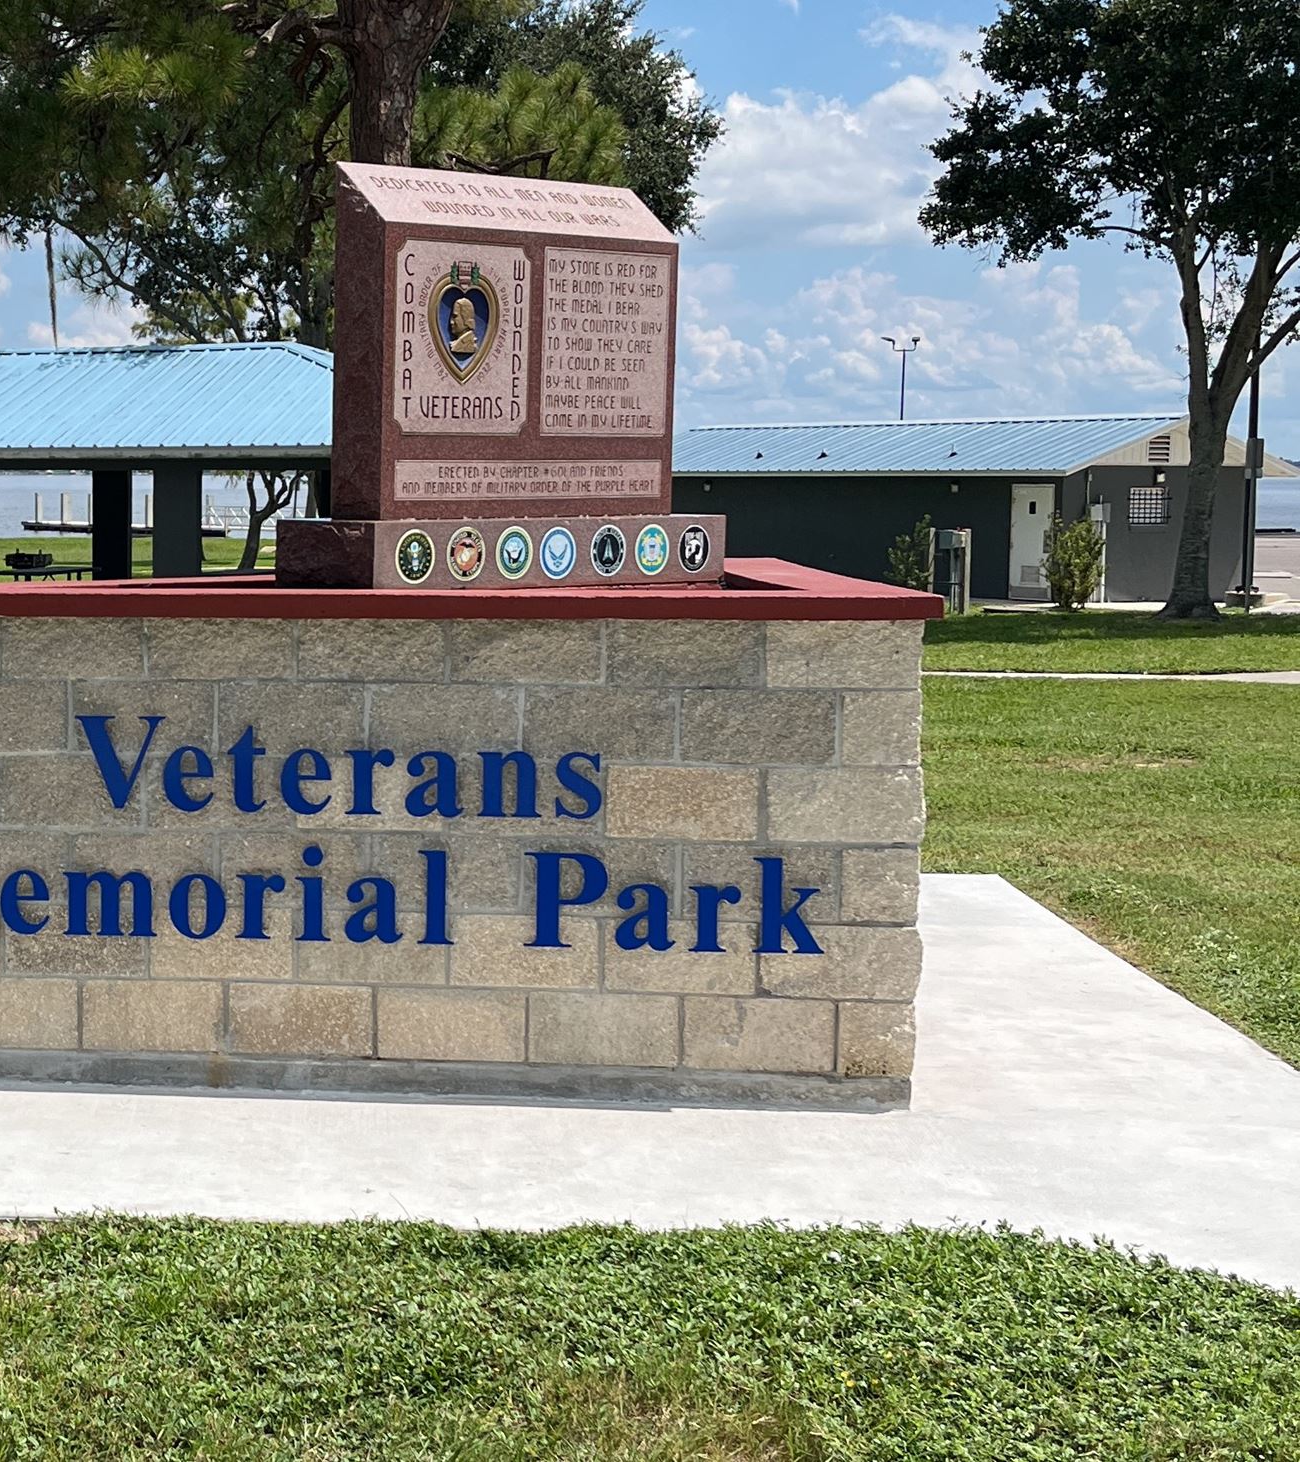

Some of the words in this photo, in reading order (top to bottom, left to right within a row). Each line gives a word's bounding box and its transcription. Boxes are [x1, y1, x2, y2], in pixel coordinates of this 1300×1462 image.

[369, 175, 456, 195] DEDICATED
[458, 183, 482, 197] TO
[483, 185, 513, 200] ALL
[514, 188, 549, 203] MEN
[548, 191, 579, 205] AND
[580, 194, 633, 210] WOMEN
[422, 200, 496, 218] WOUNDED
[497, 206, 517, 220] IN
[517, 208, 547, 222] ALL
[547, 210, 580, 225] OUR
[580, 213, 621, 228] WARS
[548, 258, 566, 273] MY
[570, 260, 601, 276] STONE
[604, 262, 613, 276] IS
[617, 263, 636, 278] RED
[639, 264, 658, 279] FOR
[418, 275, 434, 307] ORDER
[549, 278, 567, 293] THE
[572, 279, 605, 295] BLOOD
[609, 281, 635, 296] THEY
[639, 284, 664, 299] SHED
[548, 297, 567, 313] THE
[571, 299, 603, 315] MEDAL
[615, 301, 640, 316] BEAR
[401, 253, 416, 419] COMBAT
[547, 316, 557, 331] IS
[561, 317, 577, 332] MY
[640, 321, 663, 336] WAY
[510, 259, 526, 422] WOUNDED
[547, 336, 560, 351] TO
[565, 337, 593, 352] SHOW
[597, 338, 622, 353] THEY
[627, 339, 653, 354] CARE
[546, 356, 554, 370] IF
[567, 356, 600, 371] COULD
[604, 358, 616, 372] BE
[621, 358, 646, 373] SEEN
[545, 375, 560, 389] BY
[564, 375, 582, 390] ALL
[586, 376, 630, 391] MANKIND
[419, 395, 503, 420] VETERANS
[545, 394, 580, 409] MAYBE
[584, 395, 616, 410] PEACE
[620, 396, 642, 410] WILL
[545, 413, 573, 428] COME
[577, 414, 587, 428] IN
[591, 414, 607, 428] MY
[611, 414, 653, 429] LIFETIME
[438, 466, 480, 479] ERECTED
[483, 466, 497, 478] BY
[500, 466, 539, 479] CHAPTER
[569, 465, 587, 478] AND
[589, 465, 624, 478] FRIENDS
[402, 481, 420, 494] AND
[424, 481, 468, 494] MEMBERS
[471, 481, 482, 493] OF
[486, 481, 528, 494] MILITARY
[530, 481, 558, 493] ORDER
[561, 481, 573, 493] OF
[576, 480, 592, 492] THE
[595, 479, 625, 492] PURPLE
[629, 479, 655, 492] HEART
[75, 714, 603, 820] Veterans
[522, 850, 825, 955] Park
